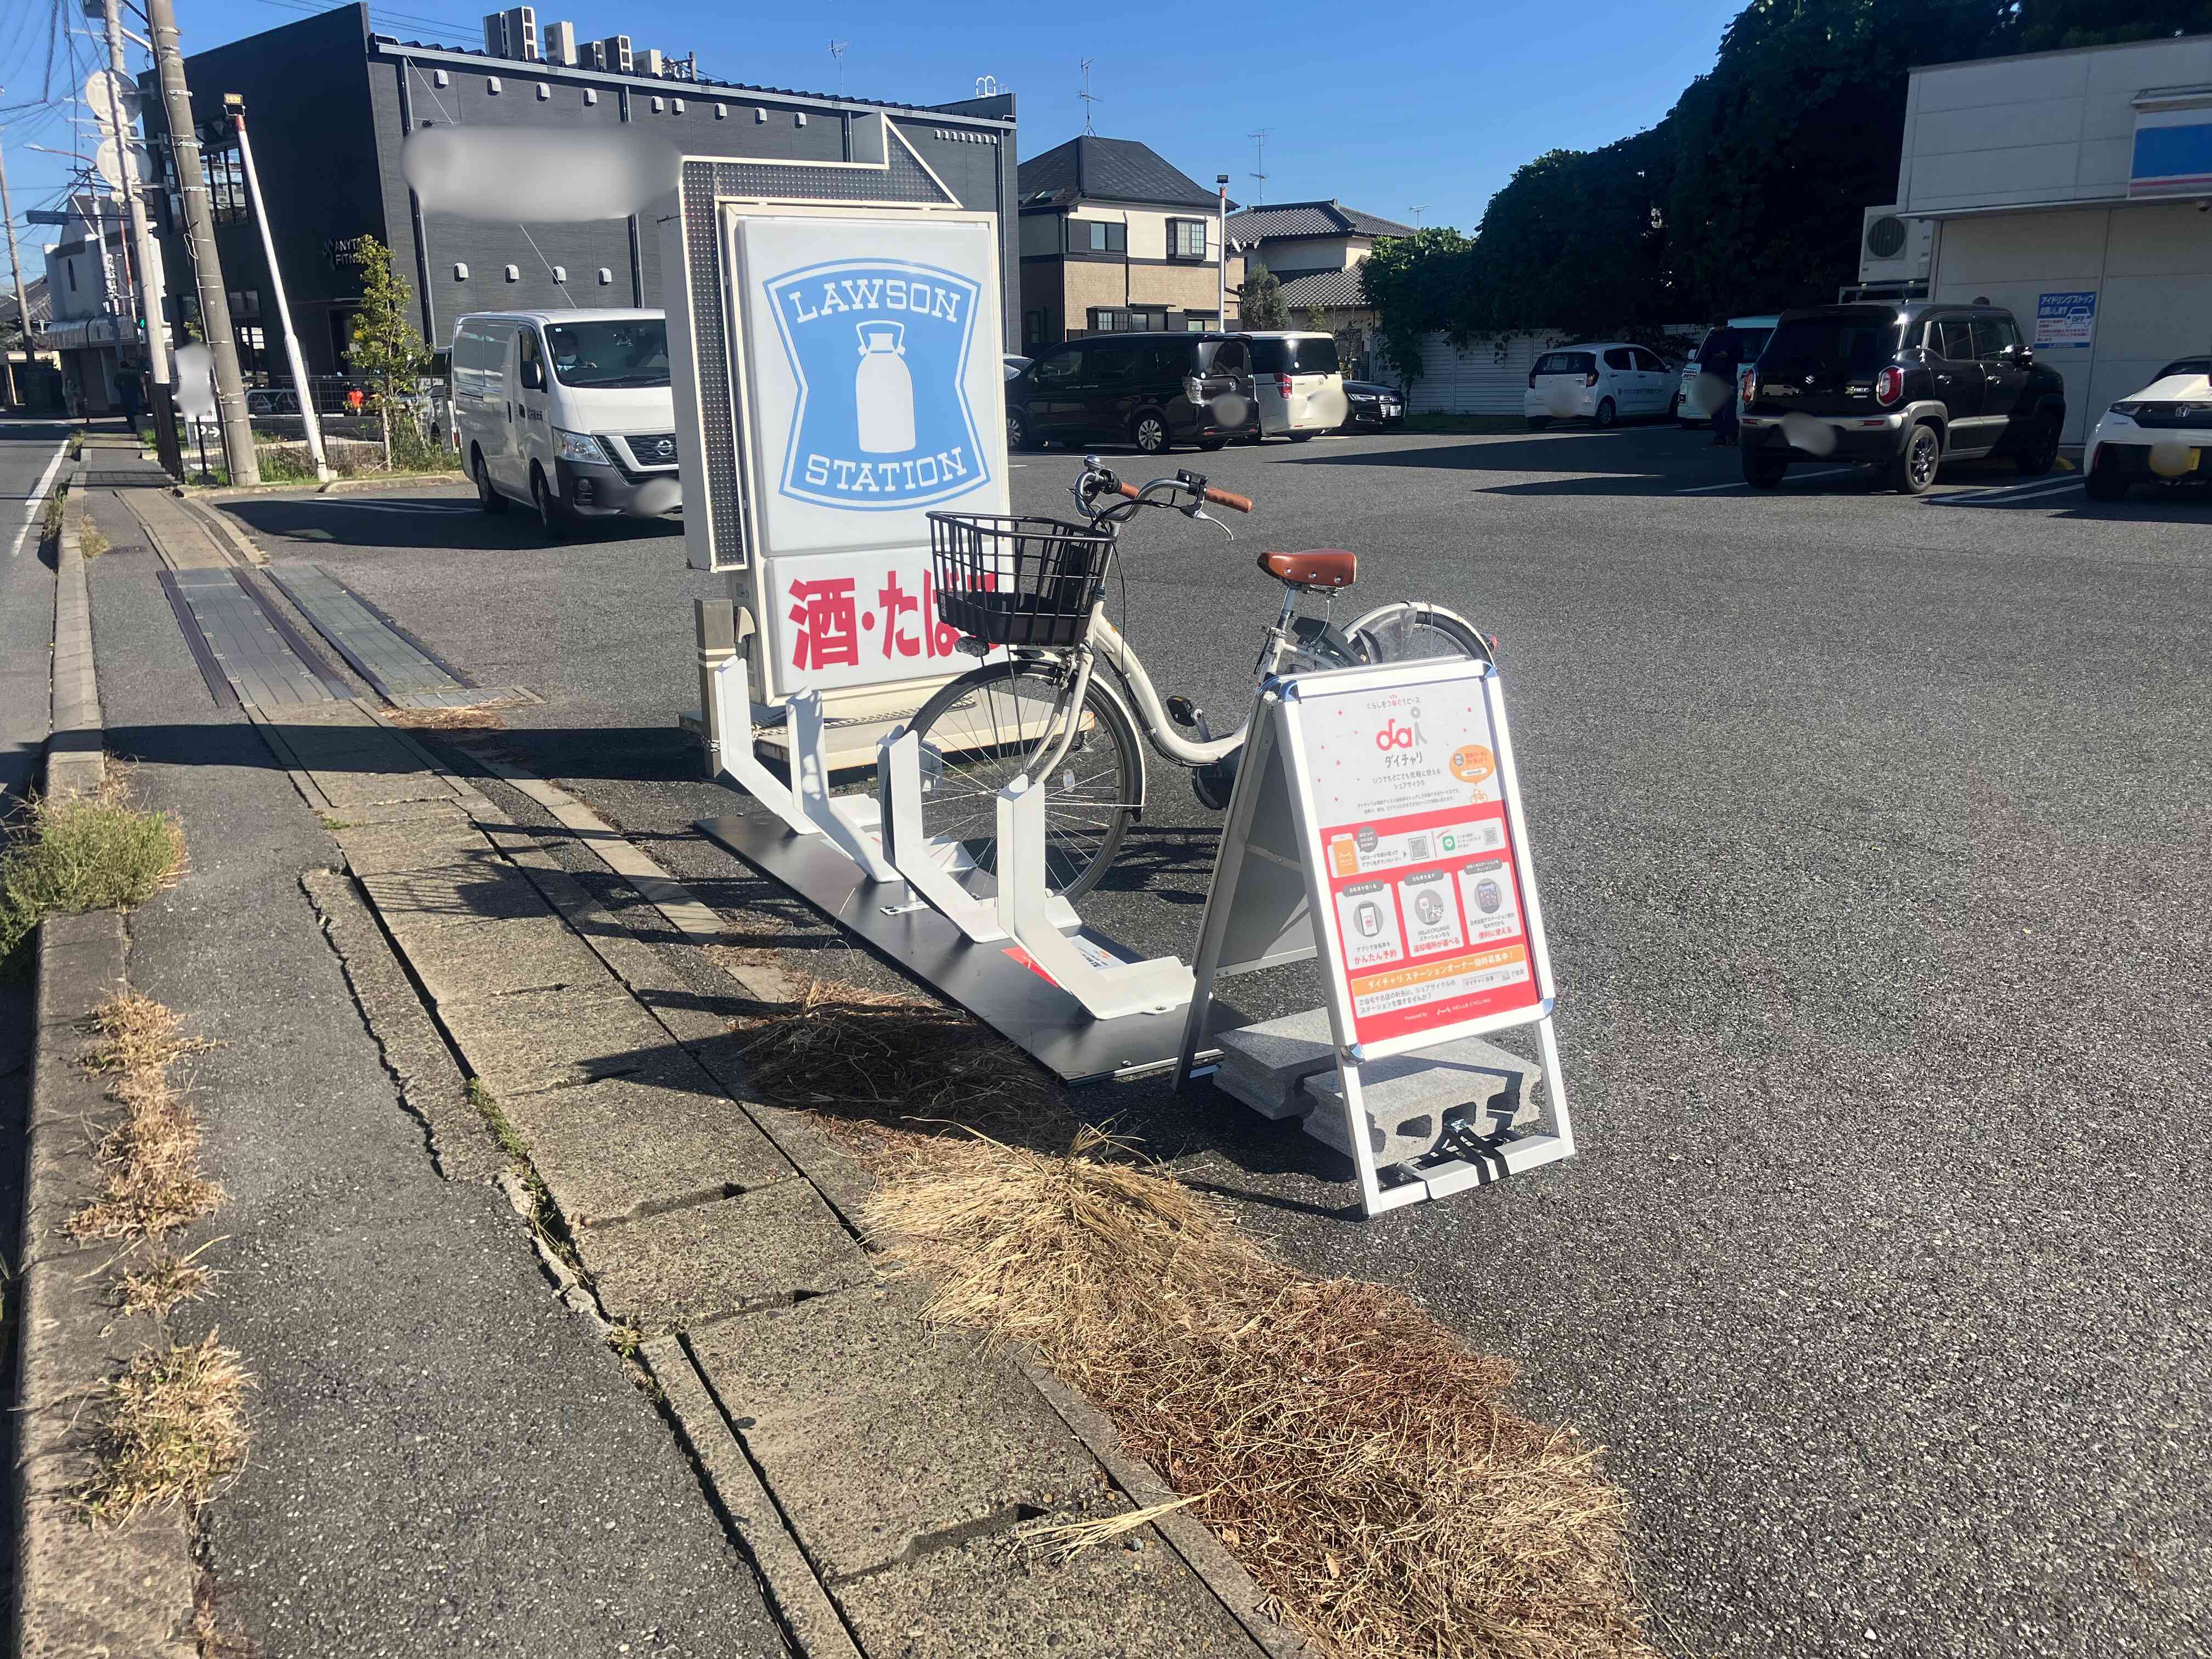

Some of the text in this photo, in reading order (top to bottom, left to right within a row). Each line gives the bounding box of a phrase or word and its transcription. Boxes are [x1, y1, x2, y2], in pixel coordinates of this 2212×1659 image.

[789, 278, 961, 324] LAWSON
[805, 447, 967, 493] STATION
[1376, 706, 1427, 751] dai
[1385, 752, 1423, 767] ダイチャリ
[1373, 768, 1441, 783] いつでもどこでも気軽に使える
[1393, 780, 1425, 789] シェアサイクル
[1412, 872, 1435, 882] 自転車を返す
[1349, 883, 1376, 893] 自転車を借りる
[1419, 931, 1450, 941] ステーションなら
[1479, 926, 1512, 939] 便利に使える
[1357, 941, 1390, 952] アプリで自転車を
[1413, 936, 1459, 952] 返却場所が選べる
[1354, 949, 1397, 965] かんたん予約
[1368, 974, 1404, 990] ダイチャリ
